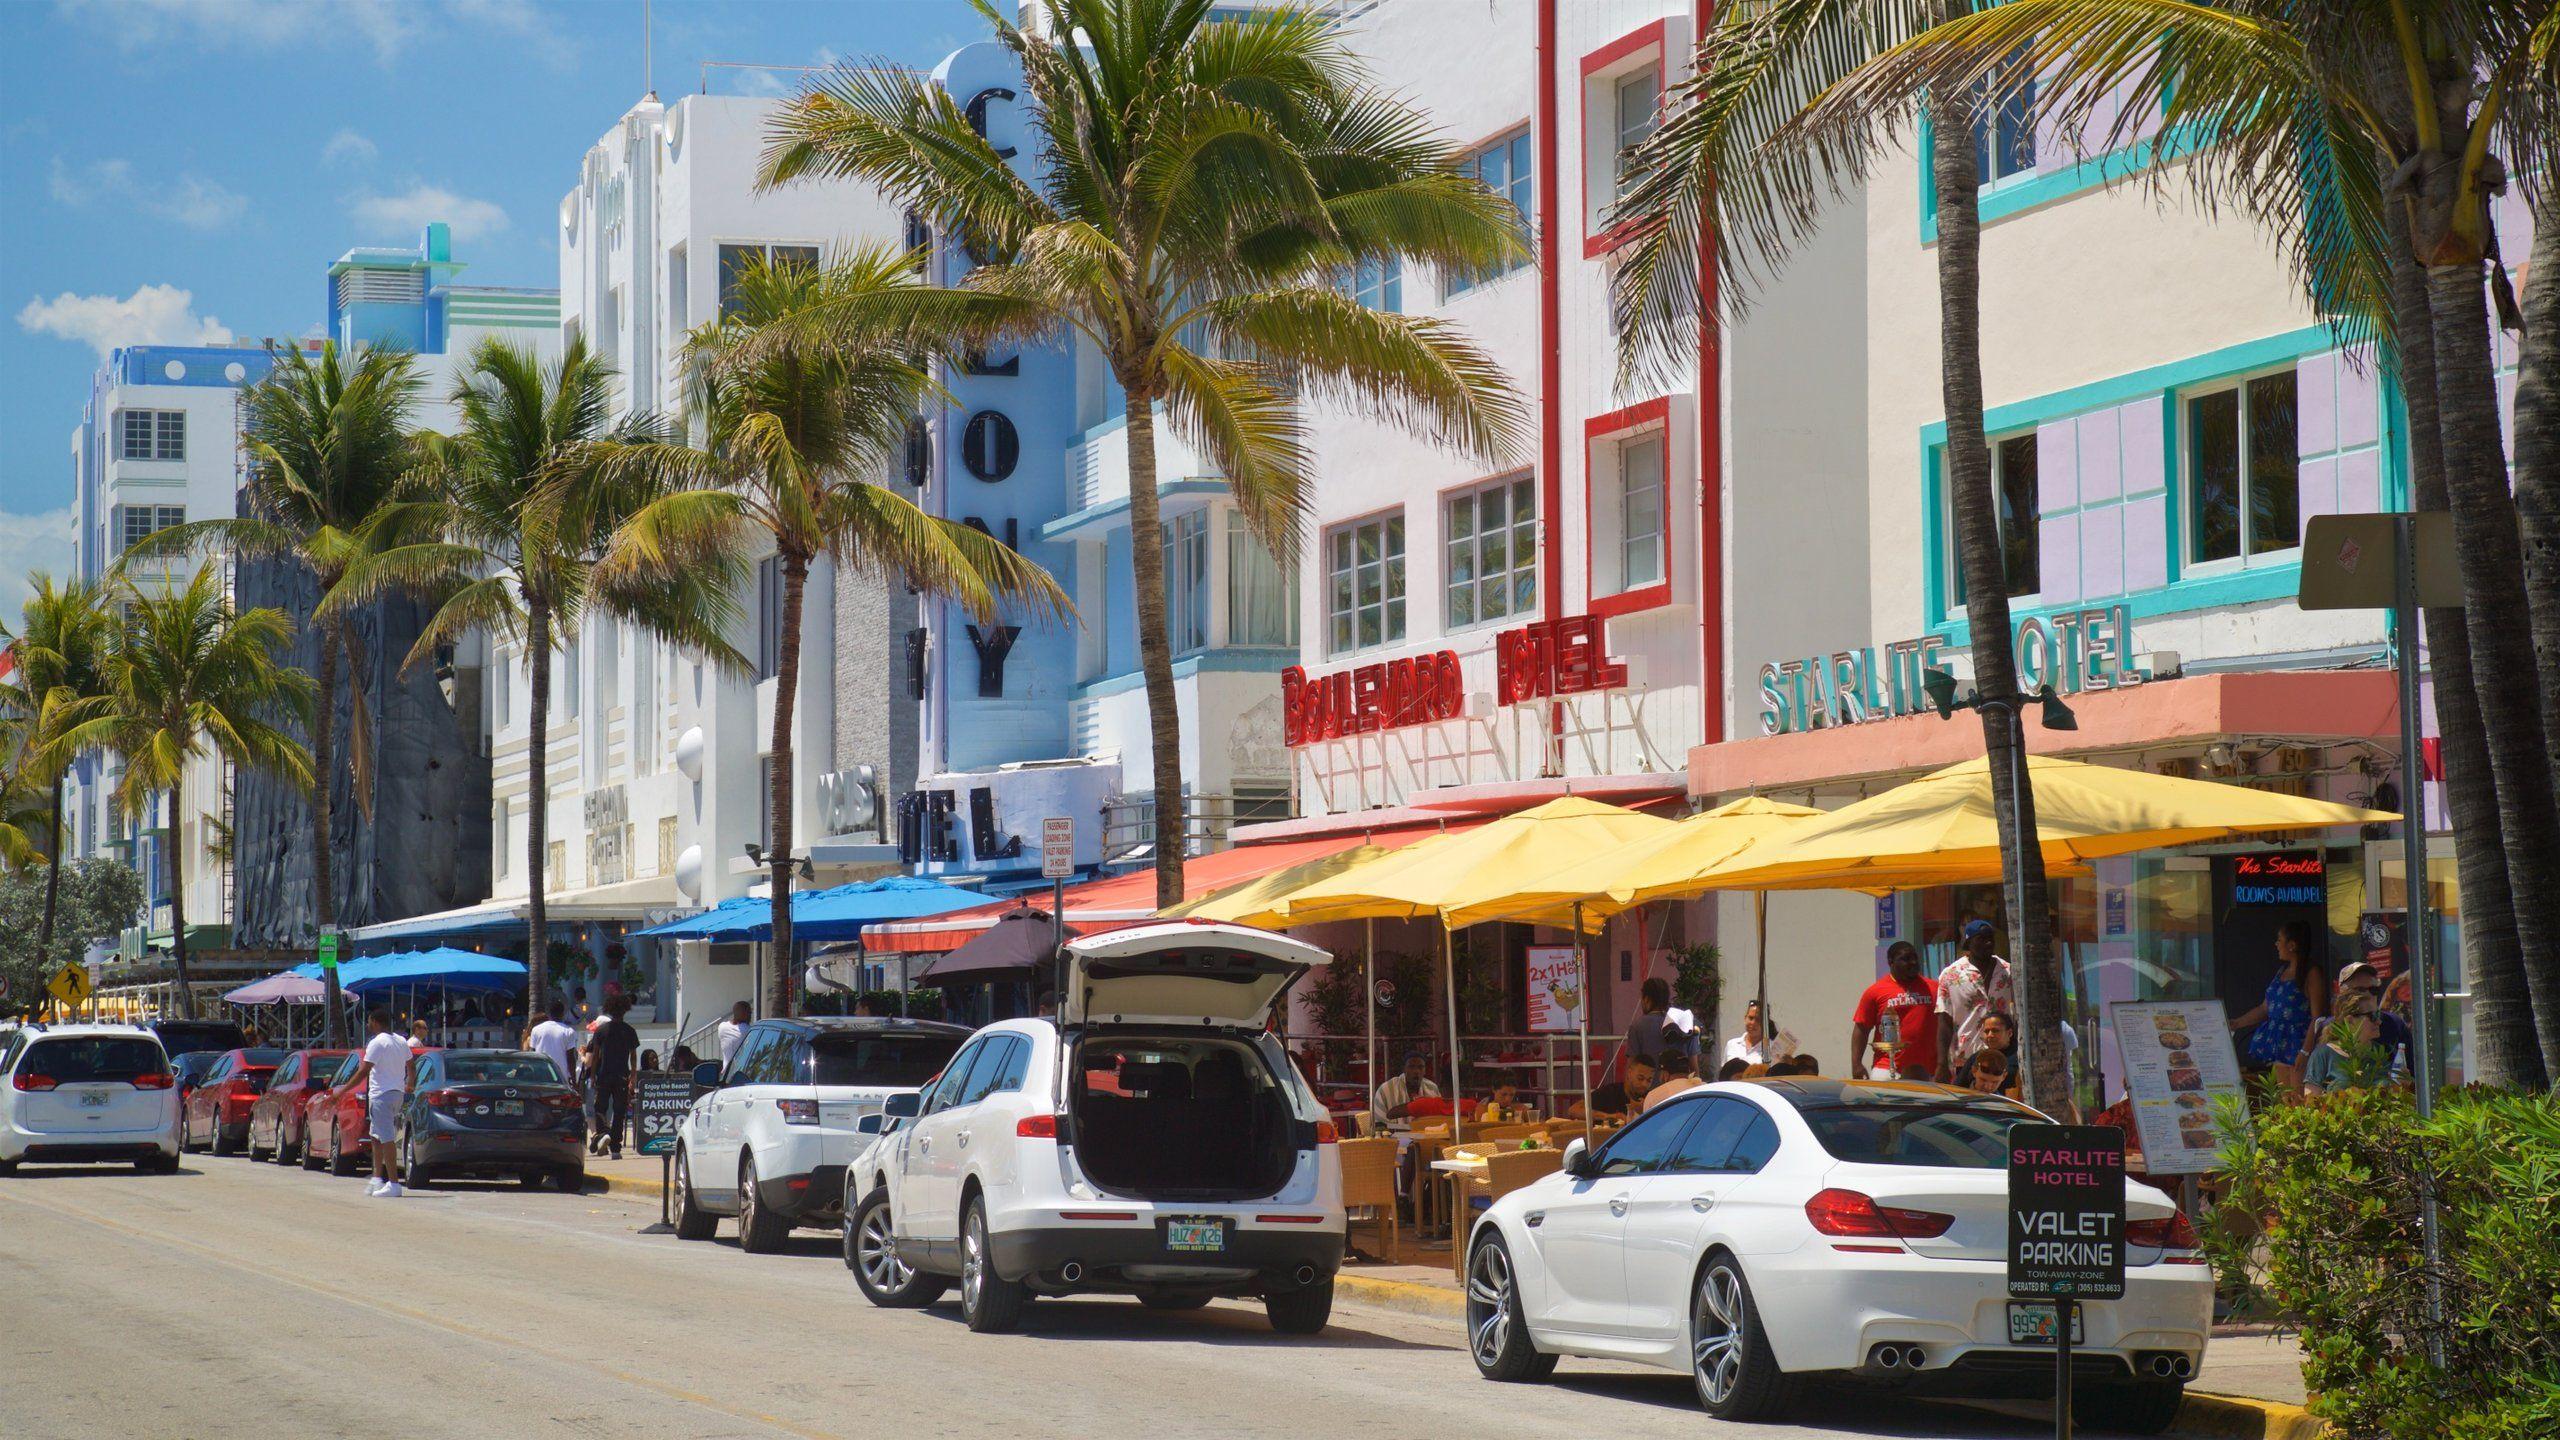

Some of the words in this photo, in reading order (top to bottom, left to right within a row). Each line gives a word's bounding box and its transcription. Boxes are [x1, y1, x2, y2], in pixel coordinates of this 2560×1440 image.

[1497, 614, 1628, 707] HOTEL
[1758, 633, 1953, 737] STARLITE
[2016, 603, 2151, 701] OTEL
[1282, 649, 1463, 747] BOULEVARD
[2234, 856, 2261, 874] The
[2265, 855, 2322, 874] Starlite
[2235, 885, 2275, 904] ROOMS
[2277, 886, 2324, 904] AVAILABL
[298, 994, 325, 1003] VALE
[642, 1099, 692, 1110] PARKING
[643, 1114, 688, 1136] $20
[2013, 1149, 2121, 1167] STARLITE
[2033, 1172, 2100, 1187] HOTEL
[2017, 1211, 2116, 1237] VALET
[2020, 1242, 2113, 1267] PARKING
[2026, 1270, 2105, 1280] TOW-AWAY-ZONE
[2010, 1281, 2039, 1292] OPERATED
[2040, 1282, 2050, 1292] BY:
[2077, 1283, 2093, 1294] (305)
[2012, 1314, 2038, 1334] 995
